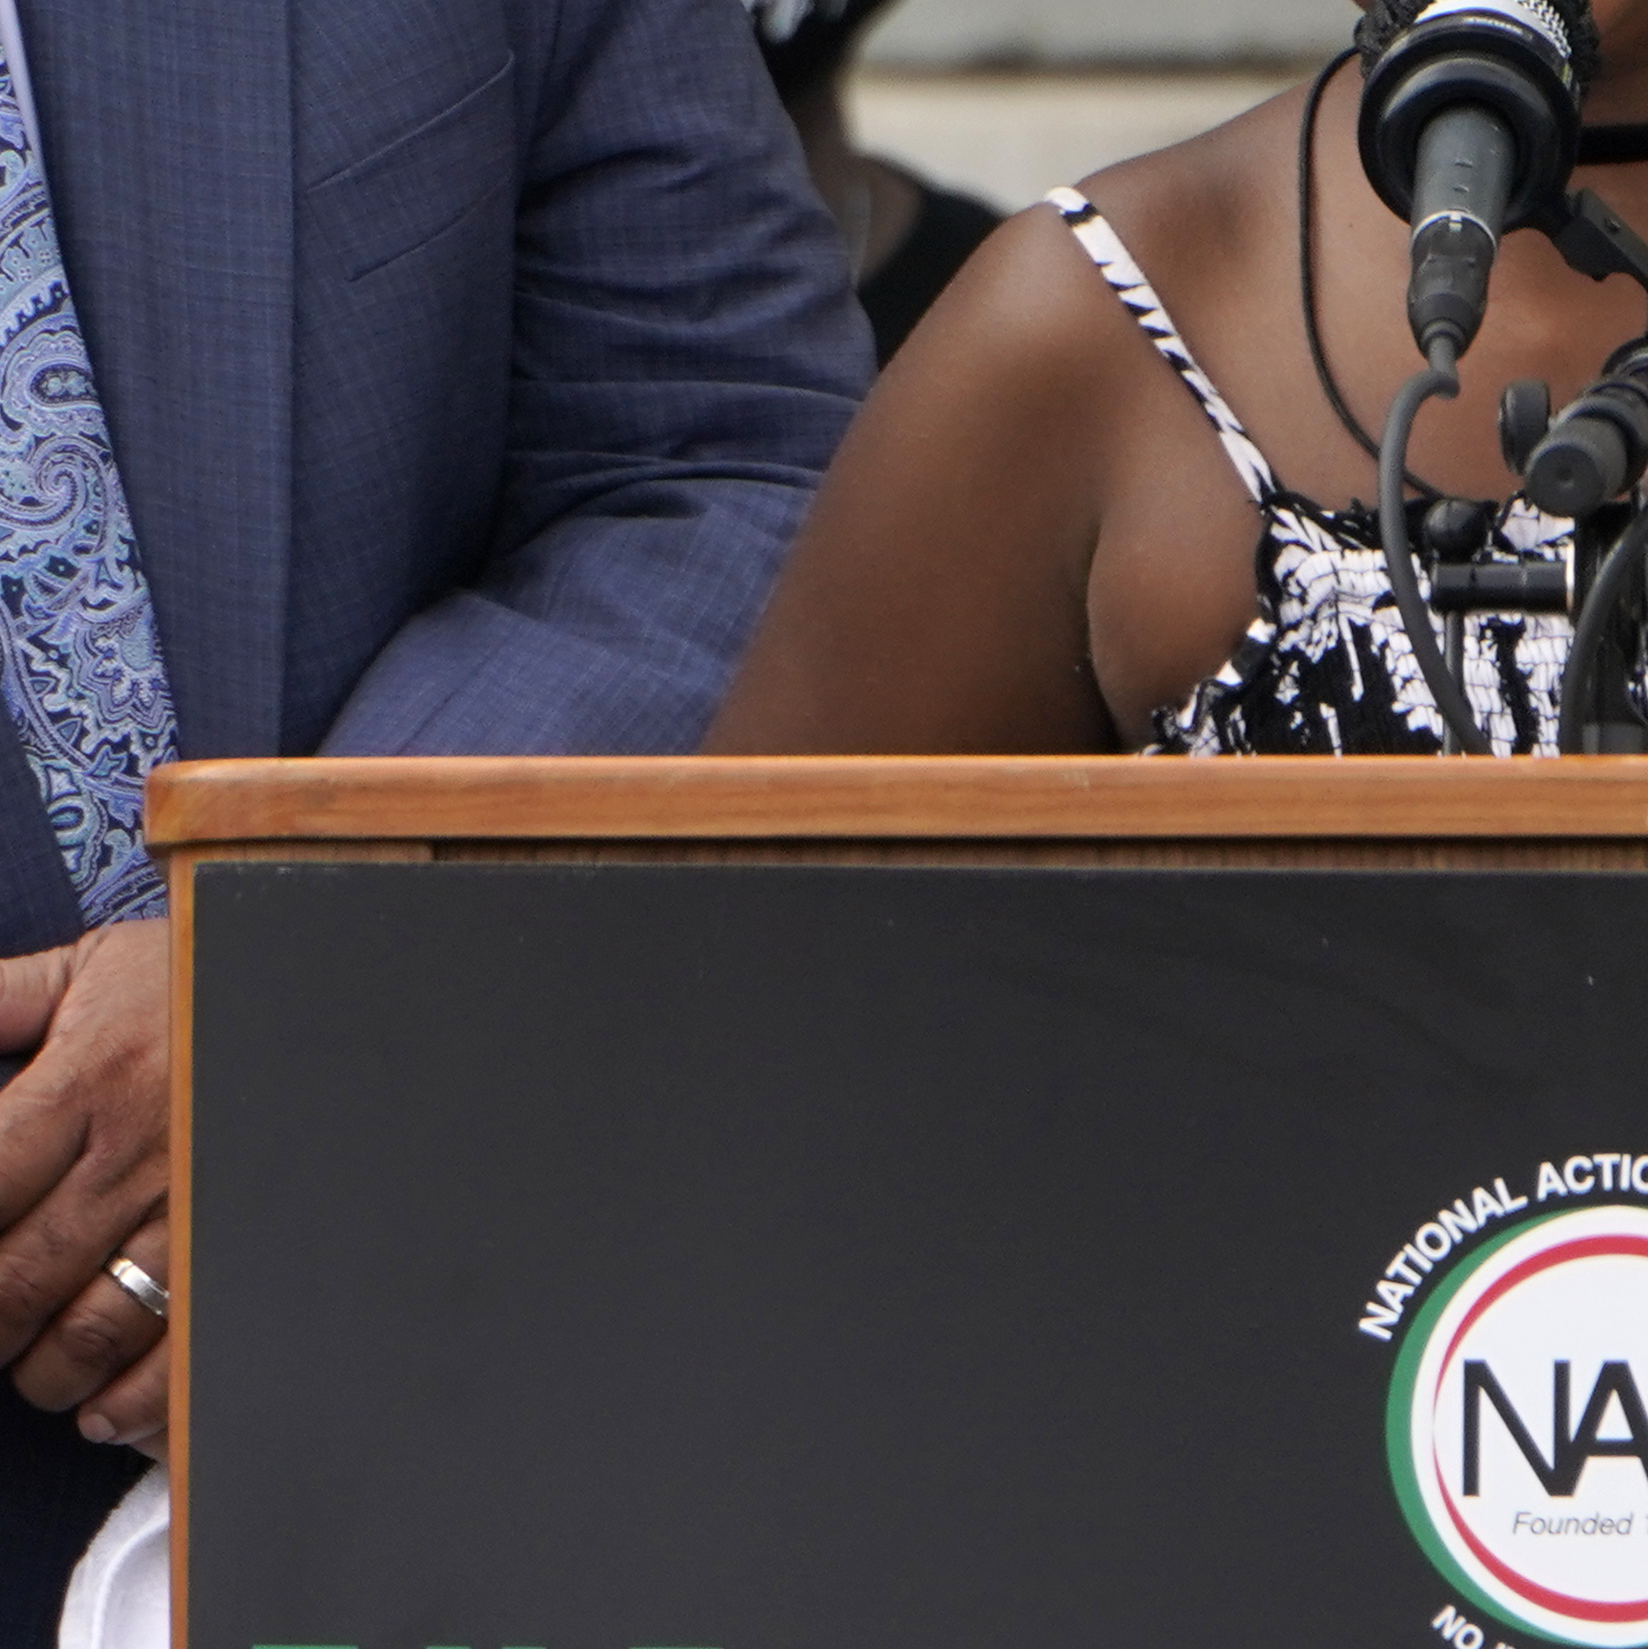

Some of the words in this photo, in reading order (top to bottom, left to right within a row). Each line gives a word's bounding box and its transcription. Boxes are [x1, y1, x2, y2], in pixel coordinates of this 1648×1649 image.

[1358, 1177, 1528, 1341] NATIONAL
[1512, 1510, 1635, 1536] Founded
[1431, 1605, 1485, 1649] NO
